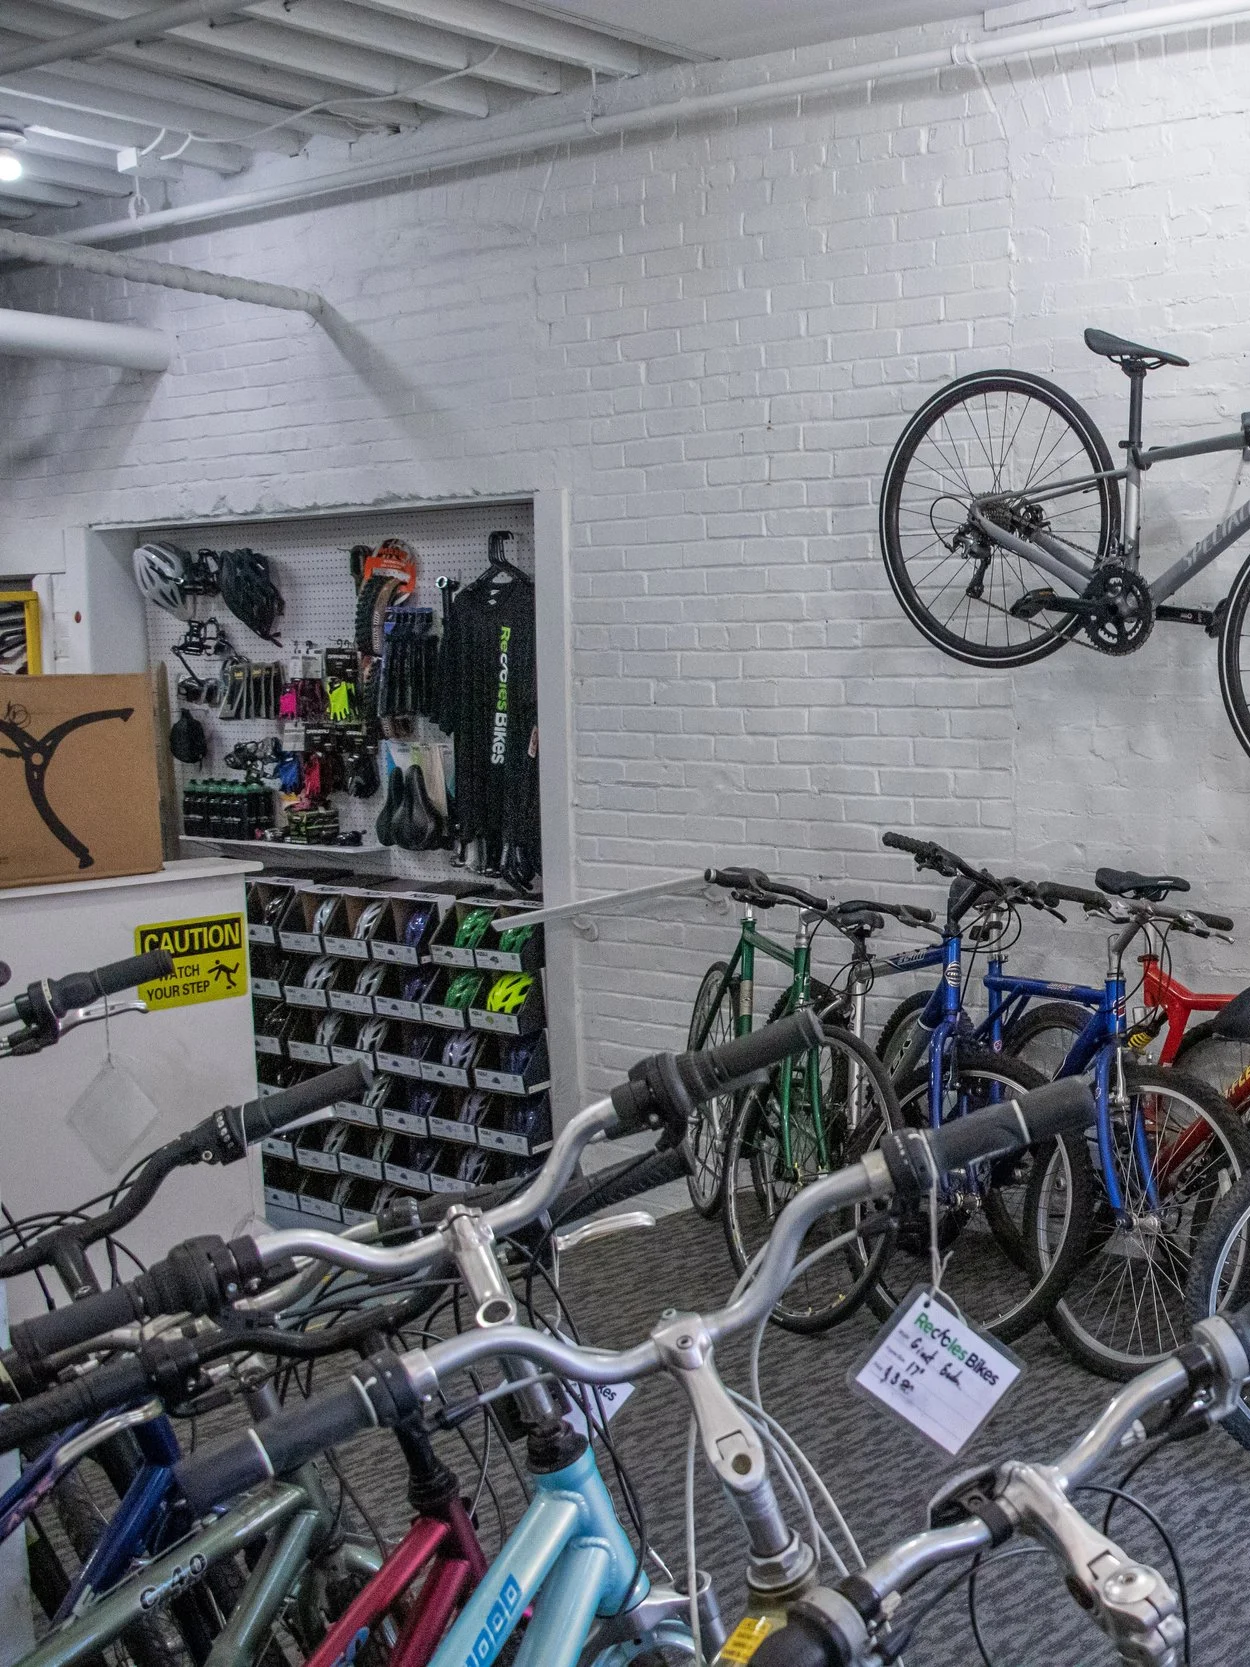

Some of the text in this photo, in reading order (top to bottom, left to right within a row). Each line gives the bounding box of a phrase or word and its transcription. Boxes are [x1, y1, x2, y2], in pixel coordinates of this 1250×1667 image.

[491, 712, 508, 765] Bikes
[144, 923, 240, 954] CAUTION
[147, 980, 210, 1001] YOUR STEP
[965, 1352, 999, 1386] Bikes
